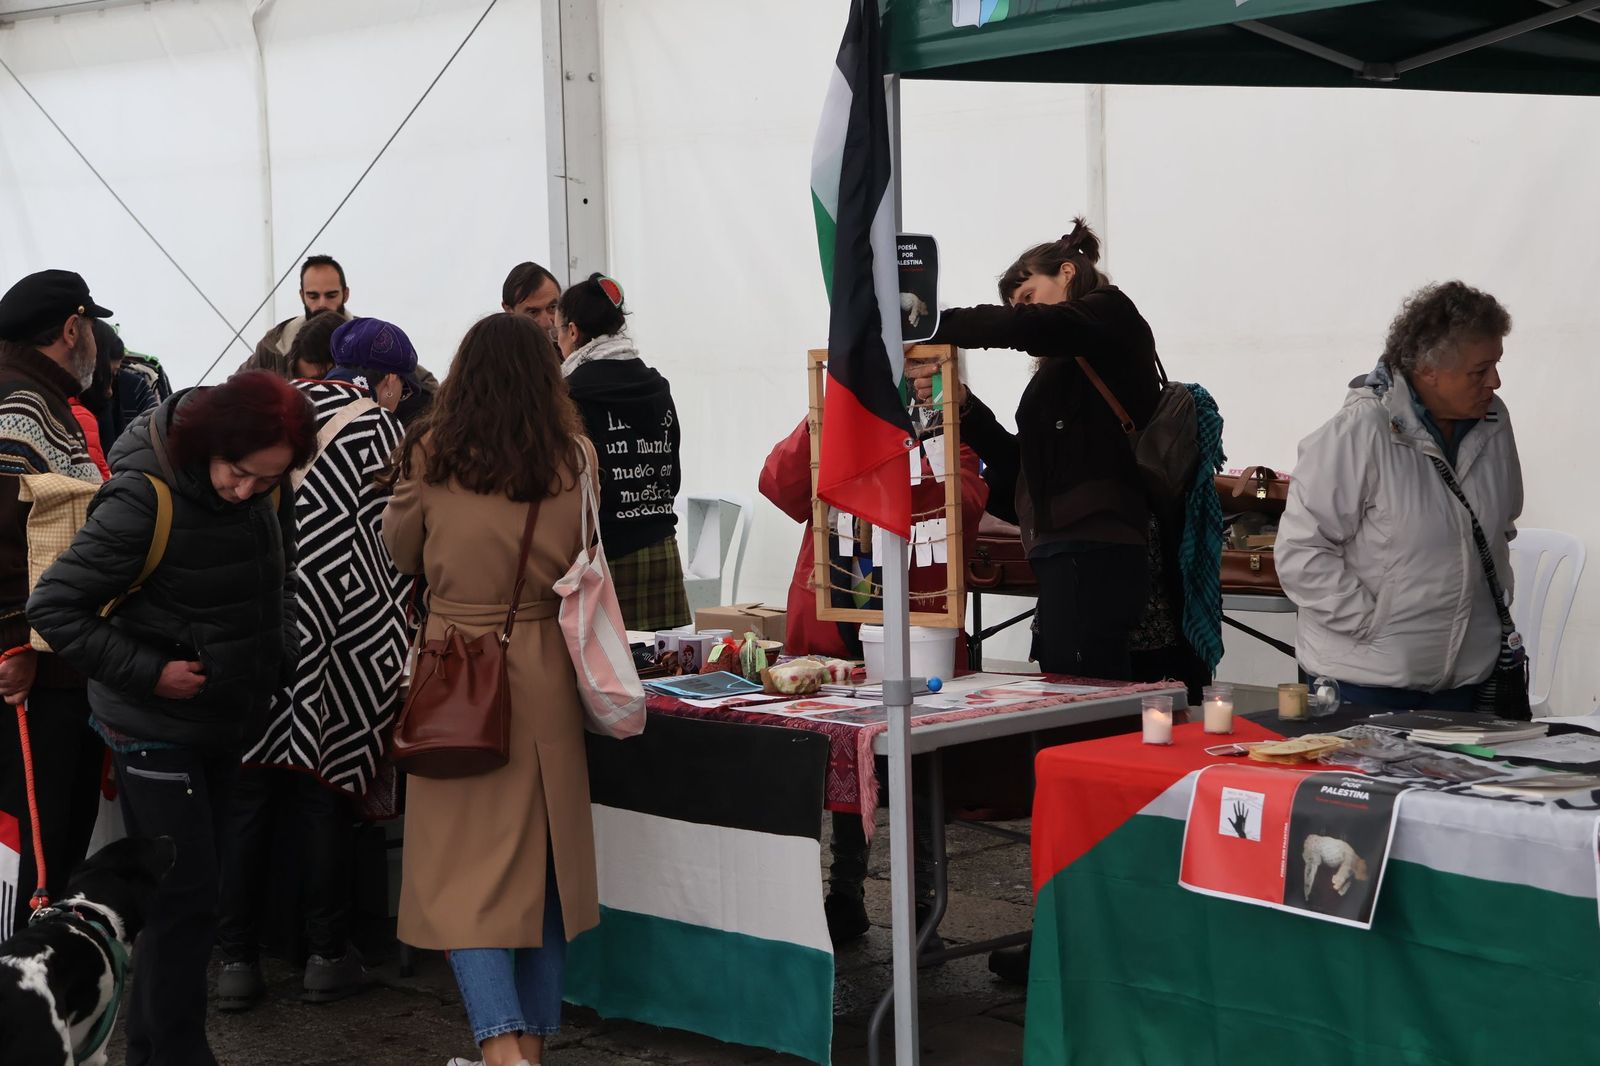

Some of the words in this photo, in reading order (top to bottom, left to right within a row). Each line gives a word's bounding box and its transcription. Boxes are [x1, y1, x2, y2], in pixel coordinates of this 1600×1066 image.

[606, 440, 628, 454] un
[612, 464, 655, 480] nuevo
[660, 464, 673, 477] en
[1320, 785, 1370, 800] PALESTINA
